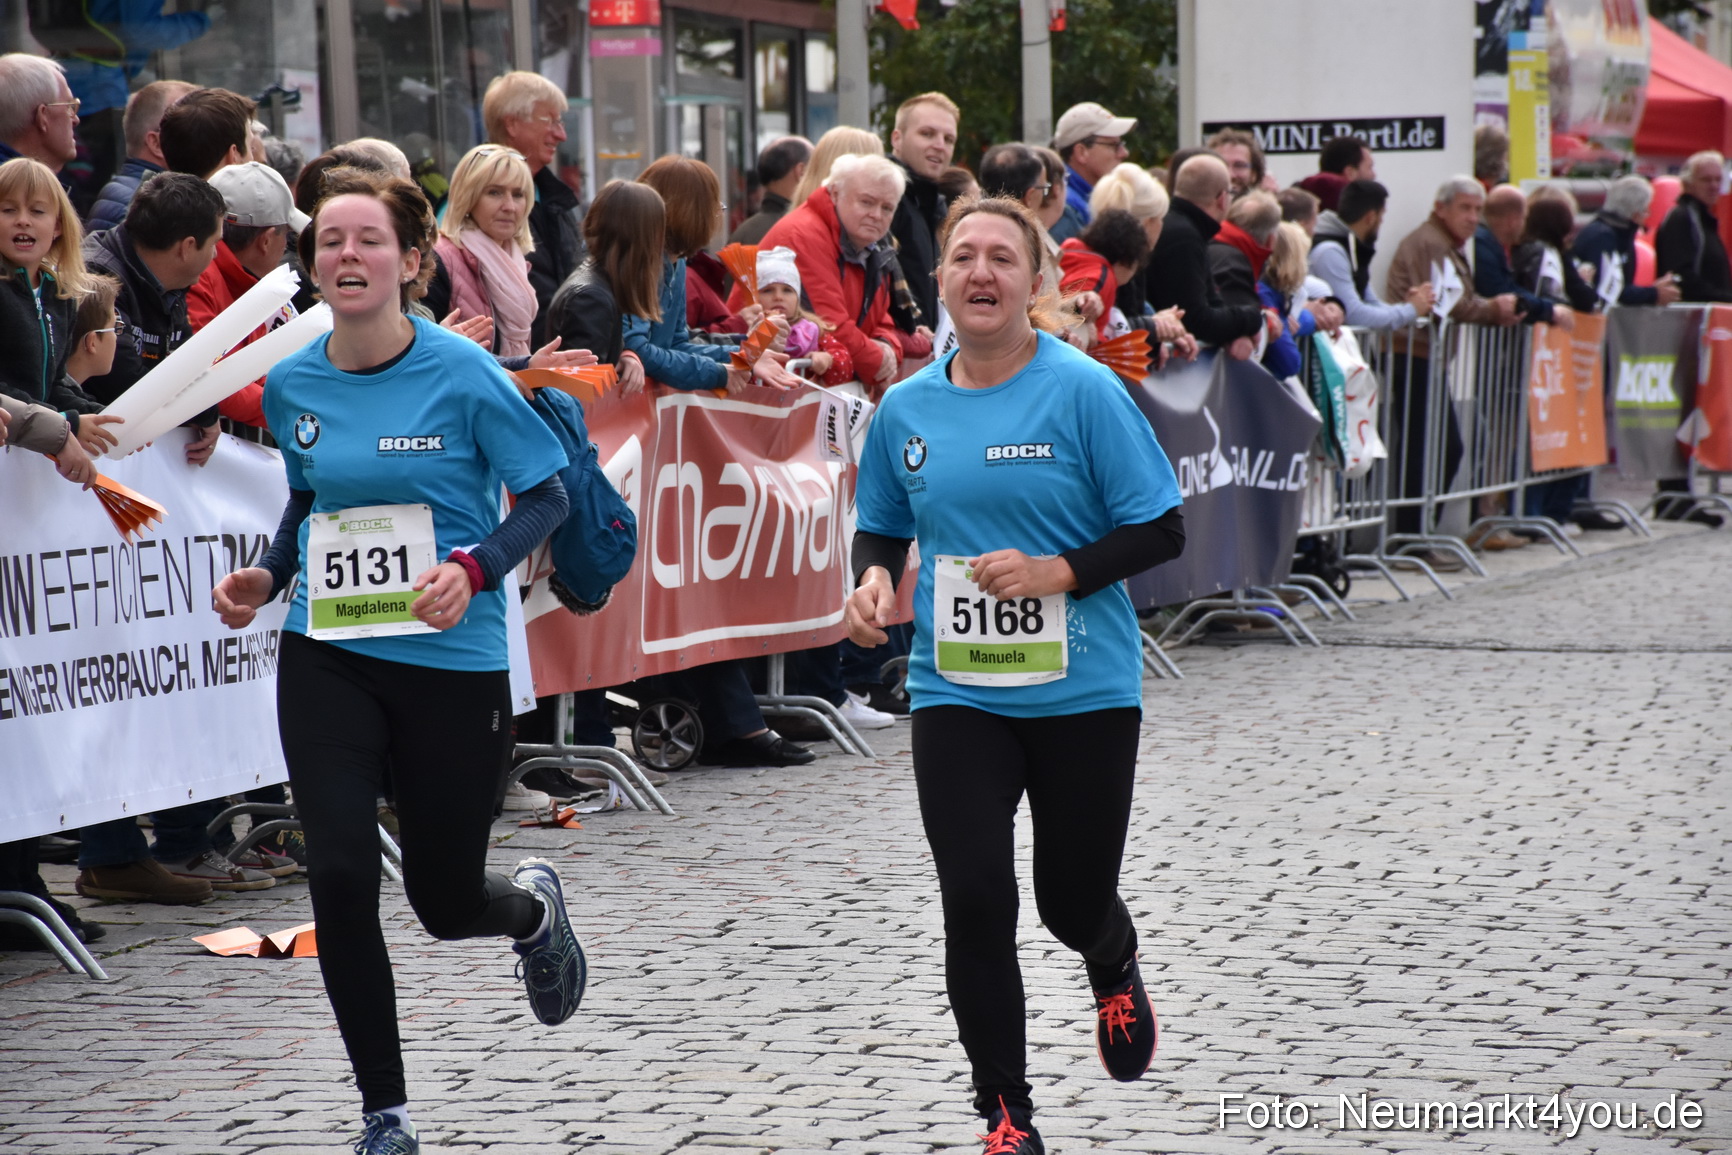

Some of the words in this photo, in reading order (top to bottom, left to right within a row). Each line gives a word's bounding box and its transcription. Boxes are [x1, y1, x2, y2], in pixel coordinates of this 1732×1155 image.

[378, 436, 443, 451] BOCK
[986, 444, 1053, 461] BOCK
[349, 518, 393, 532] BOCK
[325, 545, 409, 590] 5131
[336, 600, 407, 619] Magdalena
[952, 596, 1044, 636] 5168
[969, 650, 1026, 664] Manuela
[62, 643, 195, 710] VERBRAUCH.
